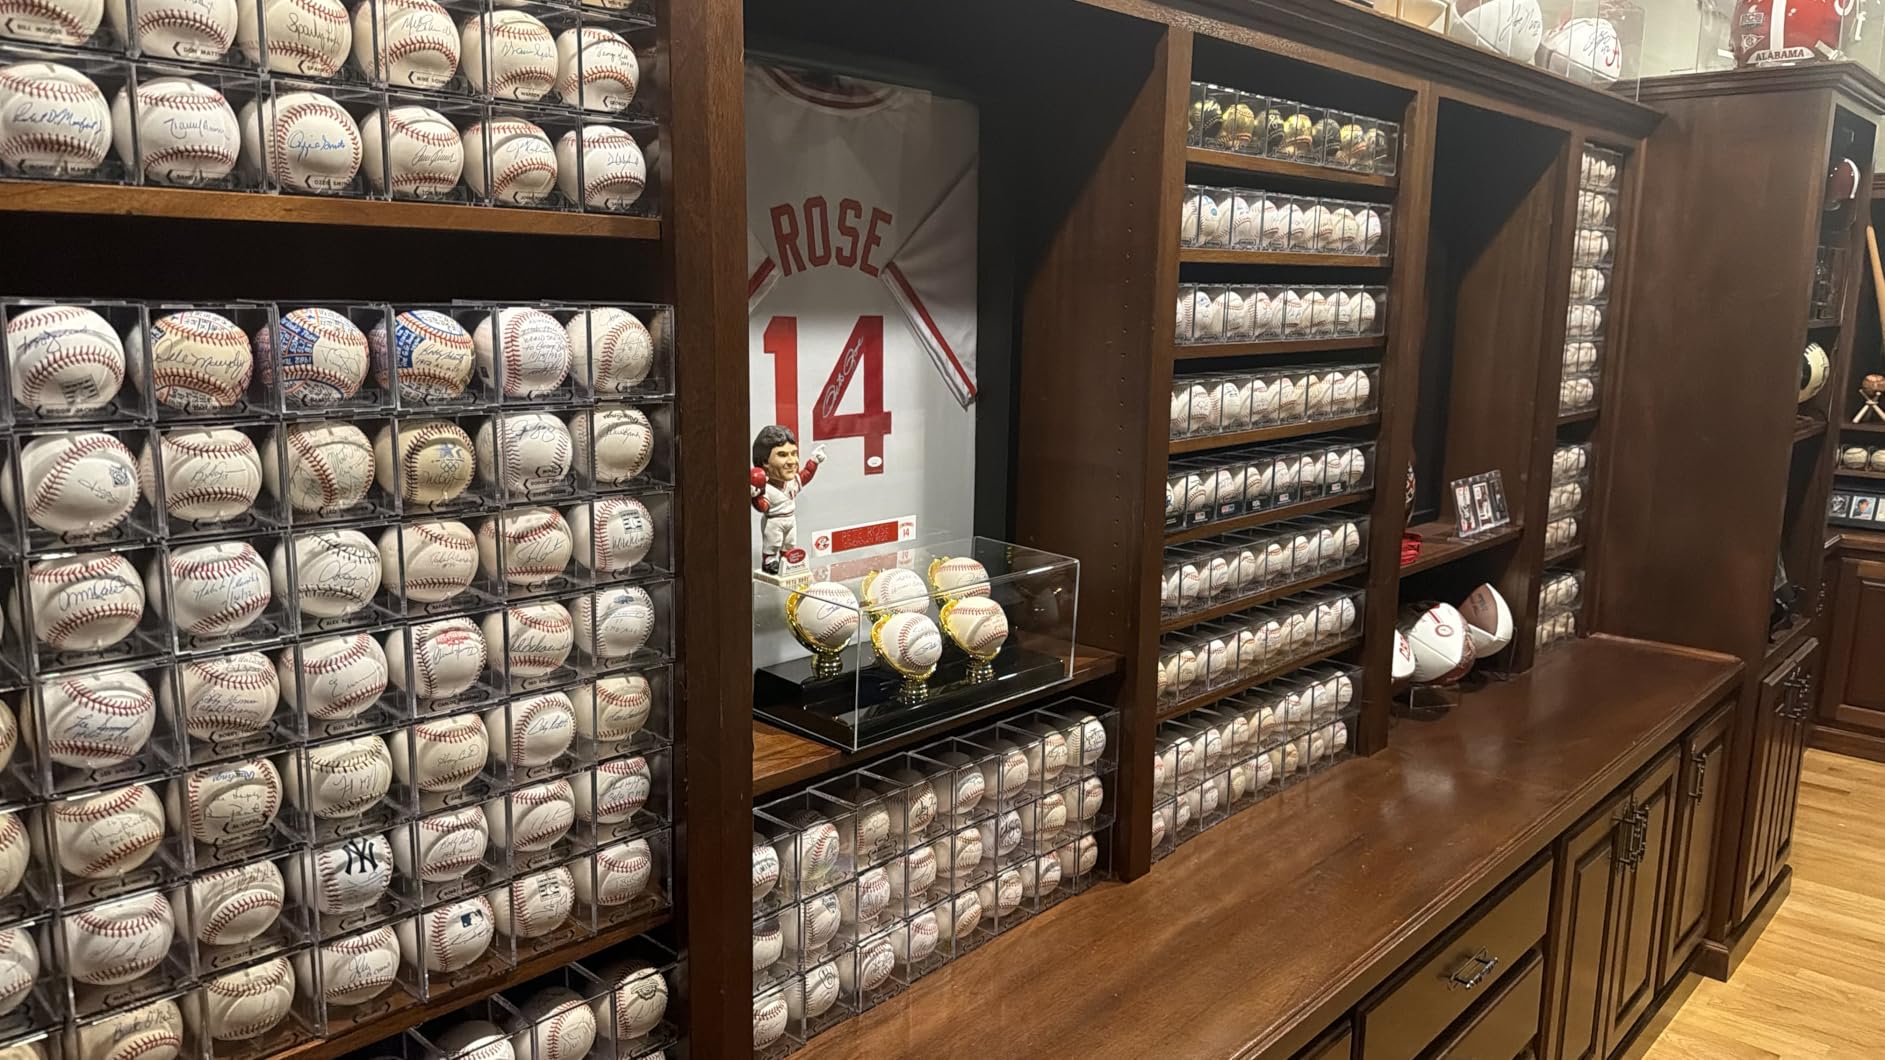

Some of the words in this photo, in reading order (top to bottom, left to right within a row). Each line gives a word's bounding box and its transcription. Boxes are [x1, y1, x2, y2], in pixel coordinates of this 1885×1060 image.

[1756, 49, 1804, 61] ALABAMA
[770, 195, 893, 279] ROSE
[763, 315, 893, 476] 14
[342, 837, 379, 876] NY
